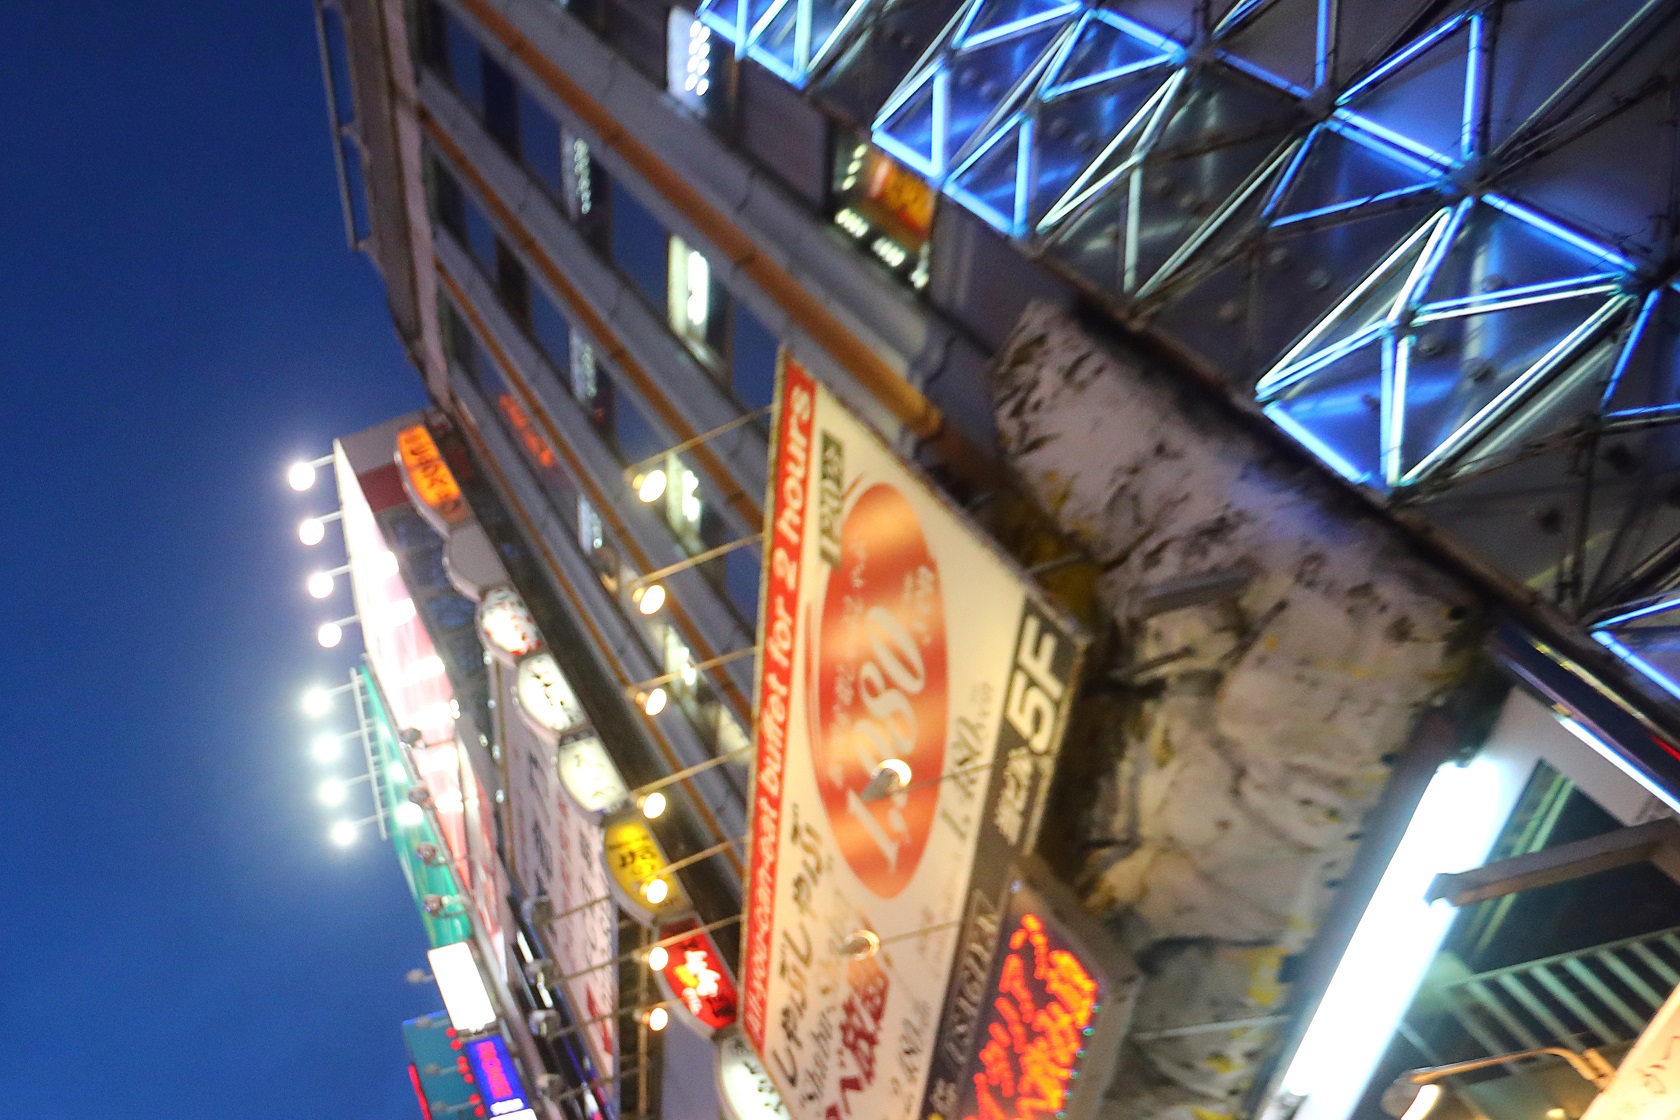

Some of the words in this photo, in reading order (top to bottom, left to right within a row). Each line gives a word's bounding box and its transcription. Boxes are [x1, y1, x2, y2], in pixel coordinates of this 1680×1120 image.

[775, 383, 816, 546] hours
[765, 595, 795, 670] for
[773, 547, 797, 594] 2
[755, 672, 787, 803] buffet
[1009, 615, 1068, 755] 5F
[775, 802, 824, 1090] しゃぶしゃぶ
